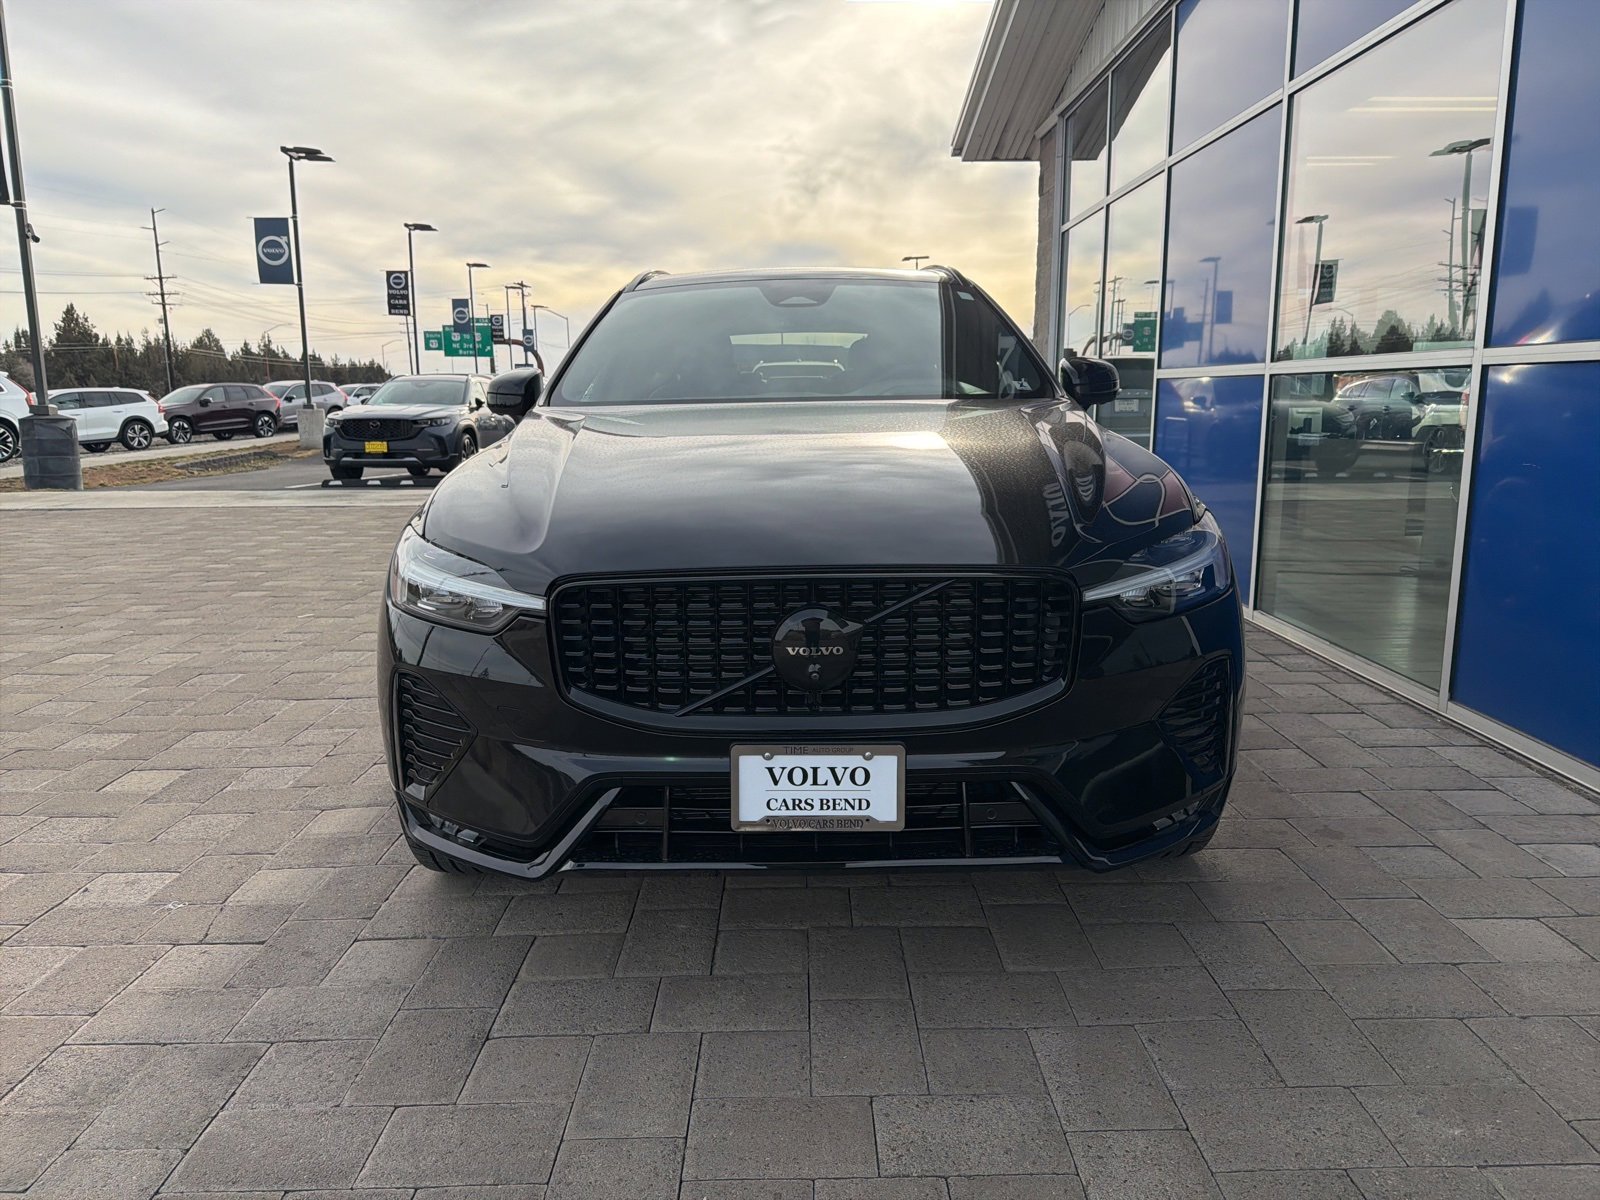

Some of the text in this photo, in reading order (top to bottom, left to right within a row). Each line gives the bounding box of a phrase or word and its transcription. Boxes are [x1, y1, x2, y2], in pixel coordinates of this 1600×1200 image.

[786, 646, 844, 656] VOLVO
[784, 746, 809, 755] TIME
[765, 766, 871, 787] VOLVO
[766, 798, 871, 811] CARS BEND
[772, 818, 864, 829] VOLVO CARS BEND
